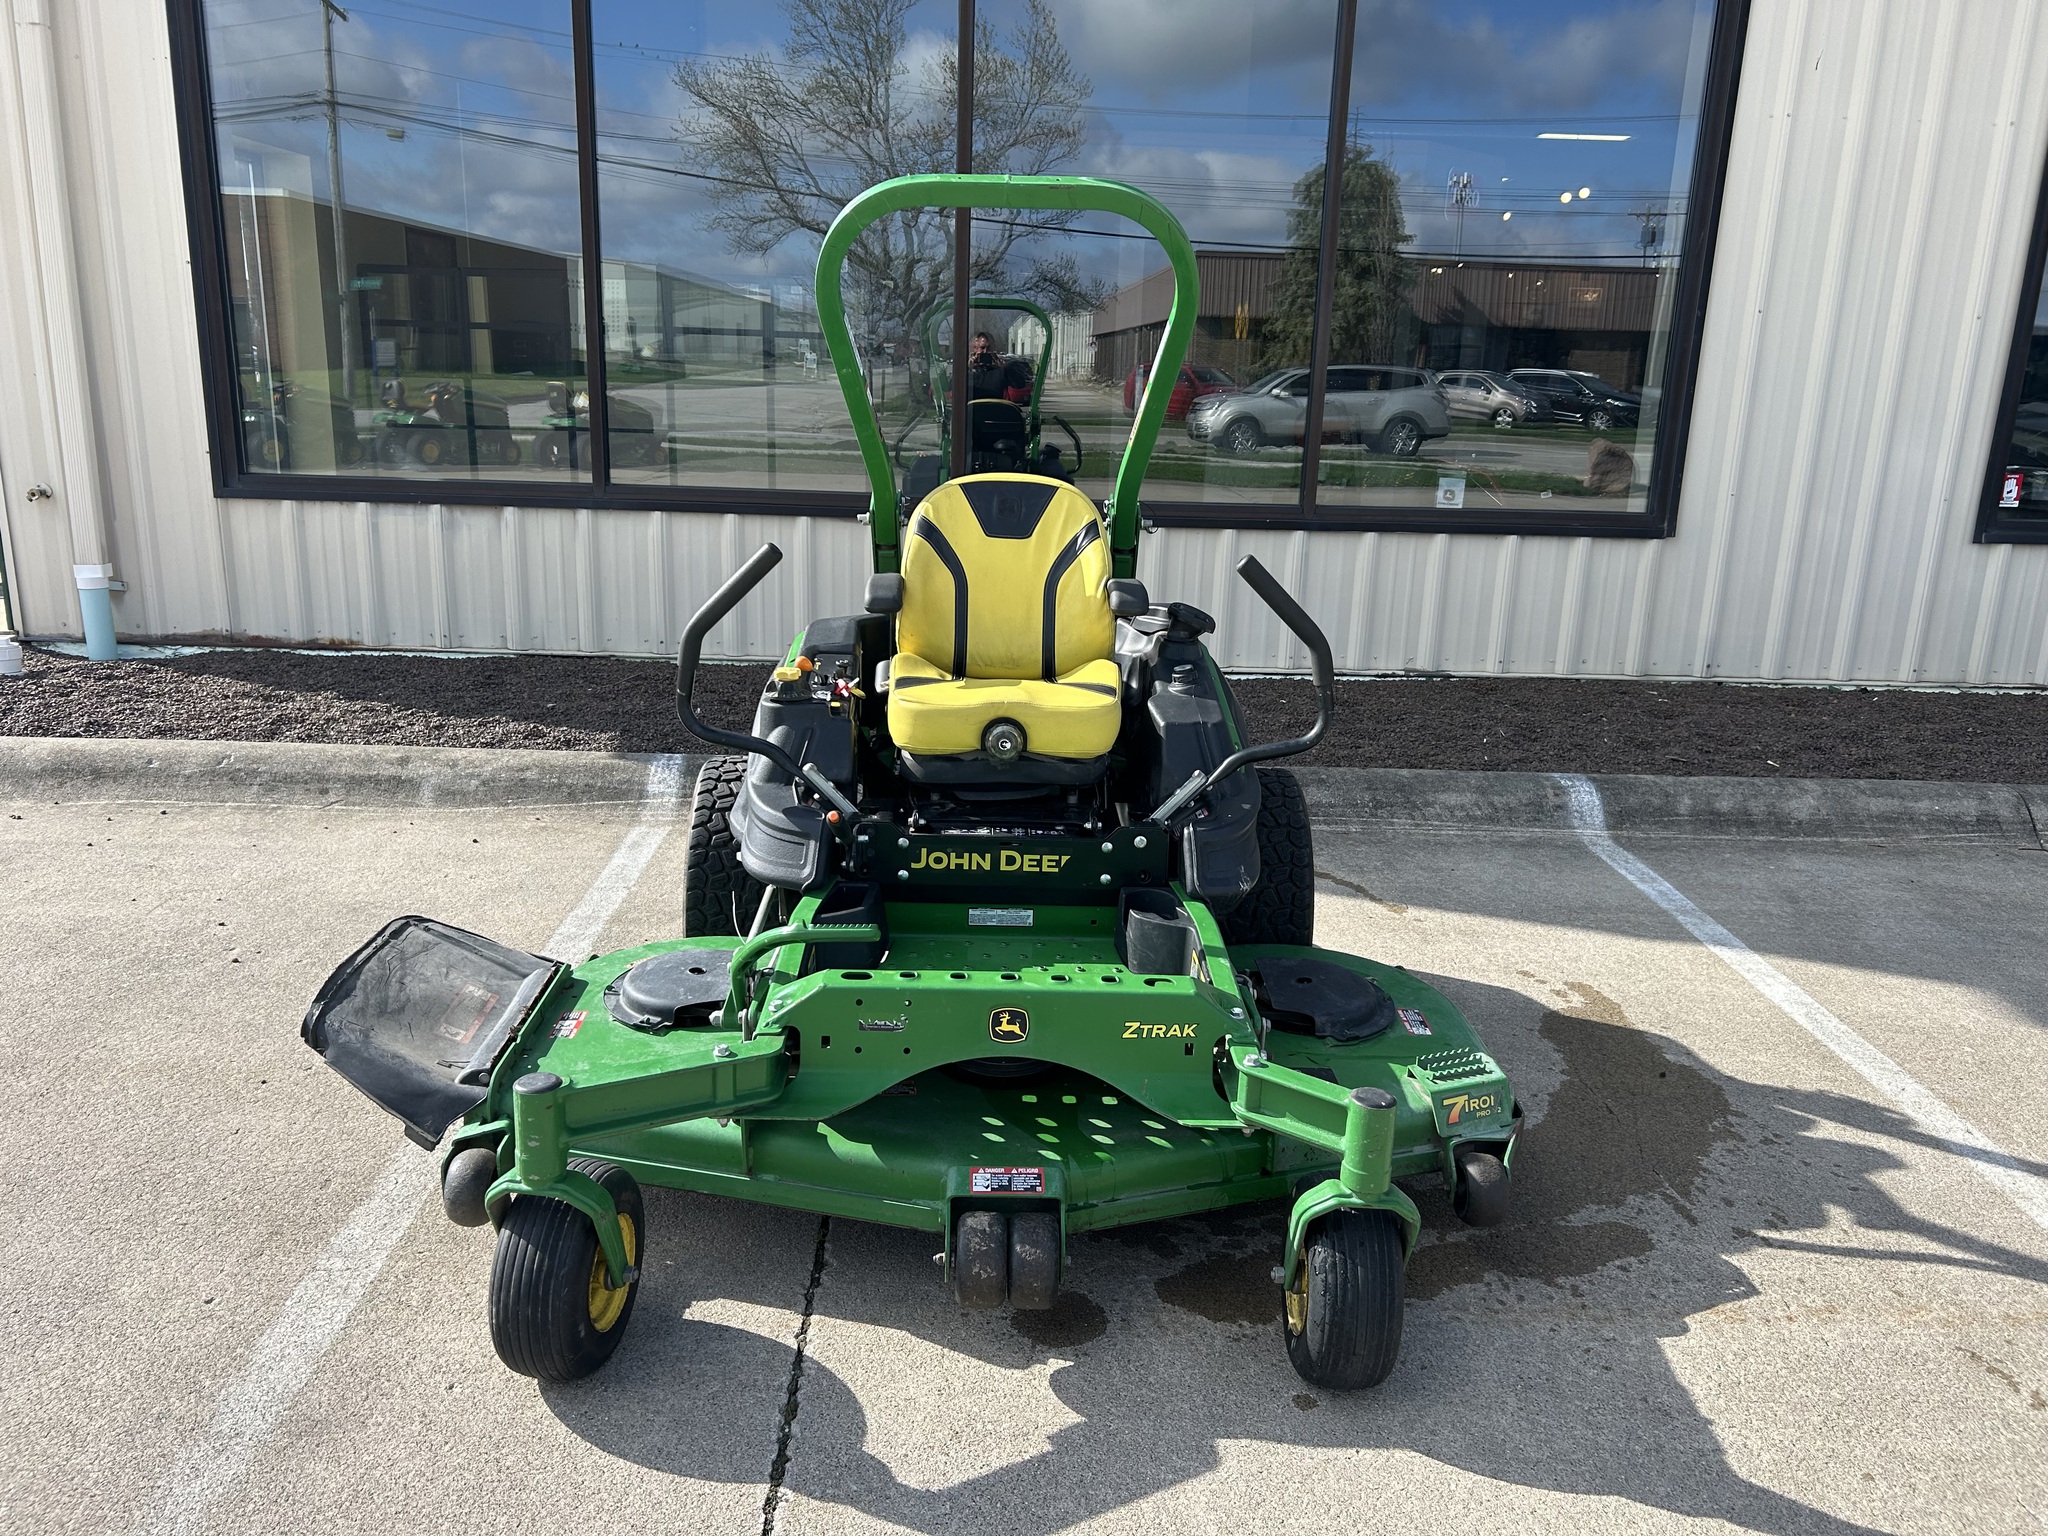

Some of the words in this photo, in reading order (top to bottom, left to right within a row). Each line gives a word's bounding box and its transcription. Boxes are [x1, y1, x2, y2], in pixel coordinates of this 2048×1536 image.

[911, 848, 991, 871] JOHN
[1122, 1021, 1198, 1039] ZTRAK
[1476, 1109, 1491, 1119] PRO
